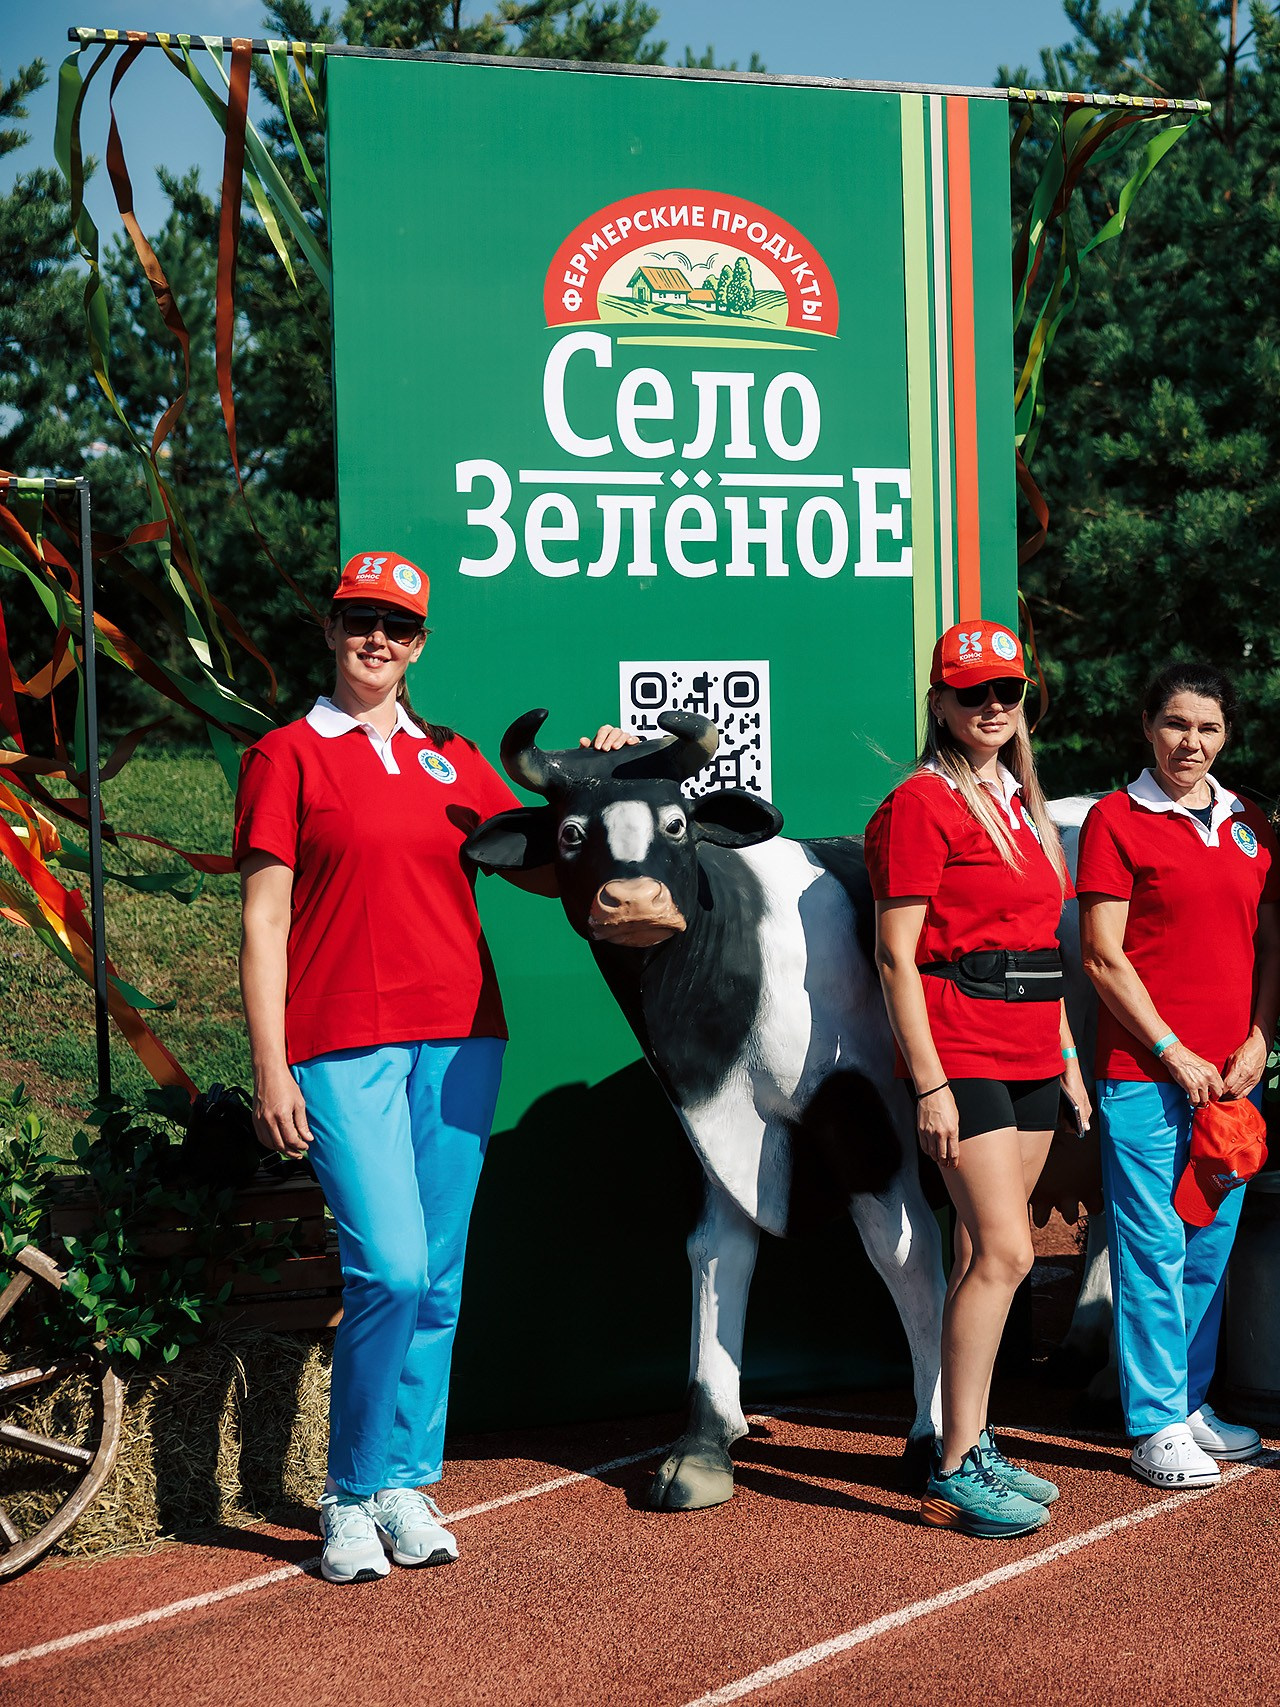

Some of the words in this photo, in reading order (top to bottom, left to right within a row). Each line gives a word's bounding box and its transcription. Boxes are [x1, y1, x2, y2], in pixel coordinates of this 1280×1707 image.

[562, 205, 704, 312] ФЕРМЕРСКИЕ
[711, 208, 822, 322] ПРОДУКТЫ
[543, 331, 821, 461] Село
[960, 653, 982, 661] КОМОС
[1147, 1468, 1185, 1482] crocs
